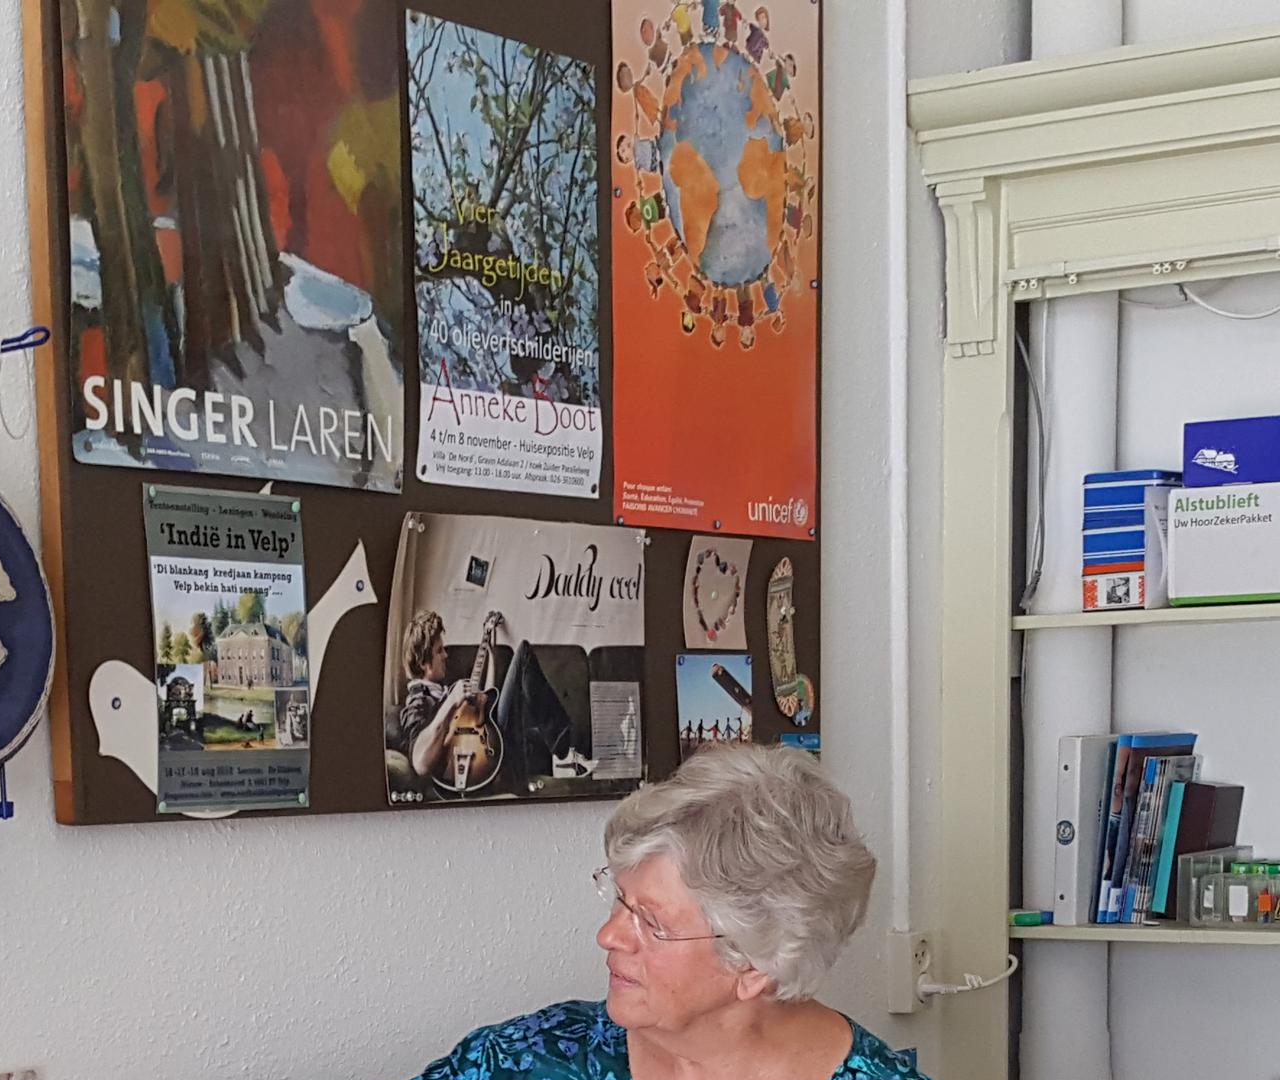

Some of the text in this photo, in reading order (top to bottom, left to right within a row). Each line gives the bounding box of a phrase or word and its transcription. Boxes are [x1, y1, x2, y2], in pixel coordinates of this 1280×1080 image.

[451, 178, 496, 225] Vier
[428, 221, 563, 300] Jaargetijden
[429, 319, 449, 344] 40
[427, 357, 528, 426] Anneke
[82, 374, 393, 464] SINGER LAREN
[430, 428, 437, 443] 4
[439, 429, 457, 446] t/m
[458, 431, 466, 446] 8
[466, 433, 513, 450] november
[519, 438, 576, 458] Huisexpositie
[577, 446, 595, 461] Velp
[747, 495, 793, 524] unicef
[1174, 491, 1261, 514] Alstublieft
[1174, 512, 1273, 529] Uw HoorZekerPakket
[226, 527, 246, 550] in
[169, 564, 209, 579] blankang
[524, 543, 642, 612] Daddy cool
[173, 580, 193, 594] Velp
[193, 581, 219, 593] bekin
[220, 582, 238, 594] hati
